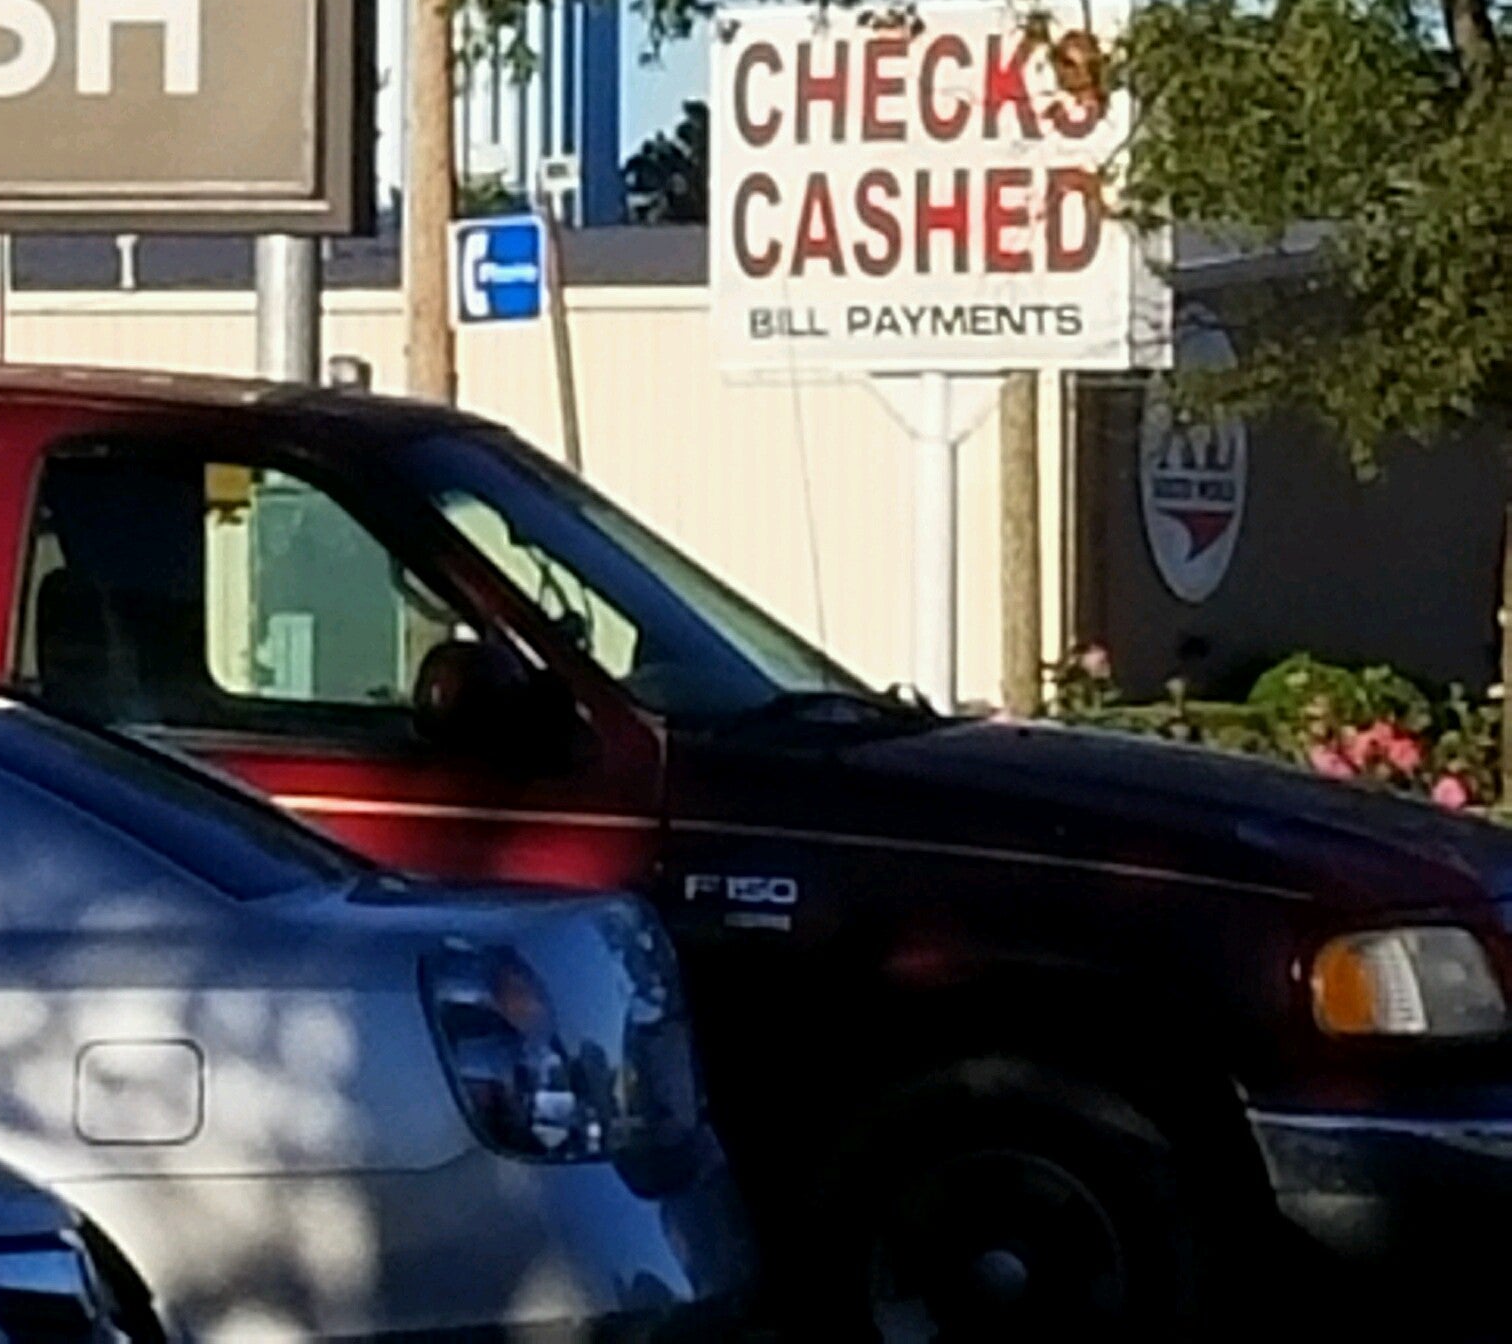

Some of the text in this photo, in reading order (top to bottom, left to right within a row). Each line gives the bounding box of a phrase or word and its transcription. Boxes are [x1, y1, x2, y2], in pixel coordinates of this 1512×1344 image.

[733, 32, 1110, 148] CHECKS
[732, 168, 1102, 279] CASHED
[749, 305, 1084, 338] BILL PAYMENTS
